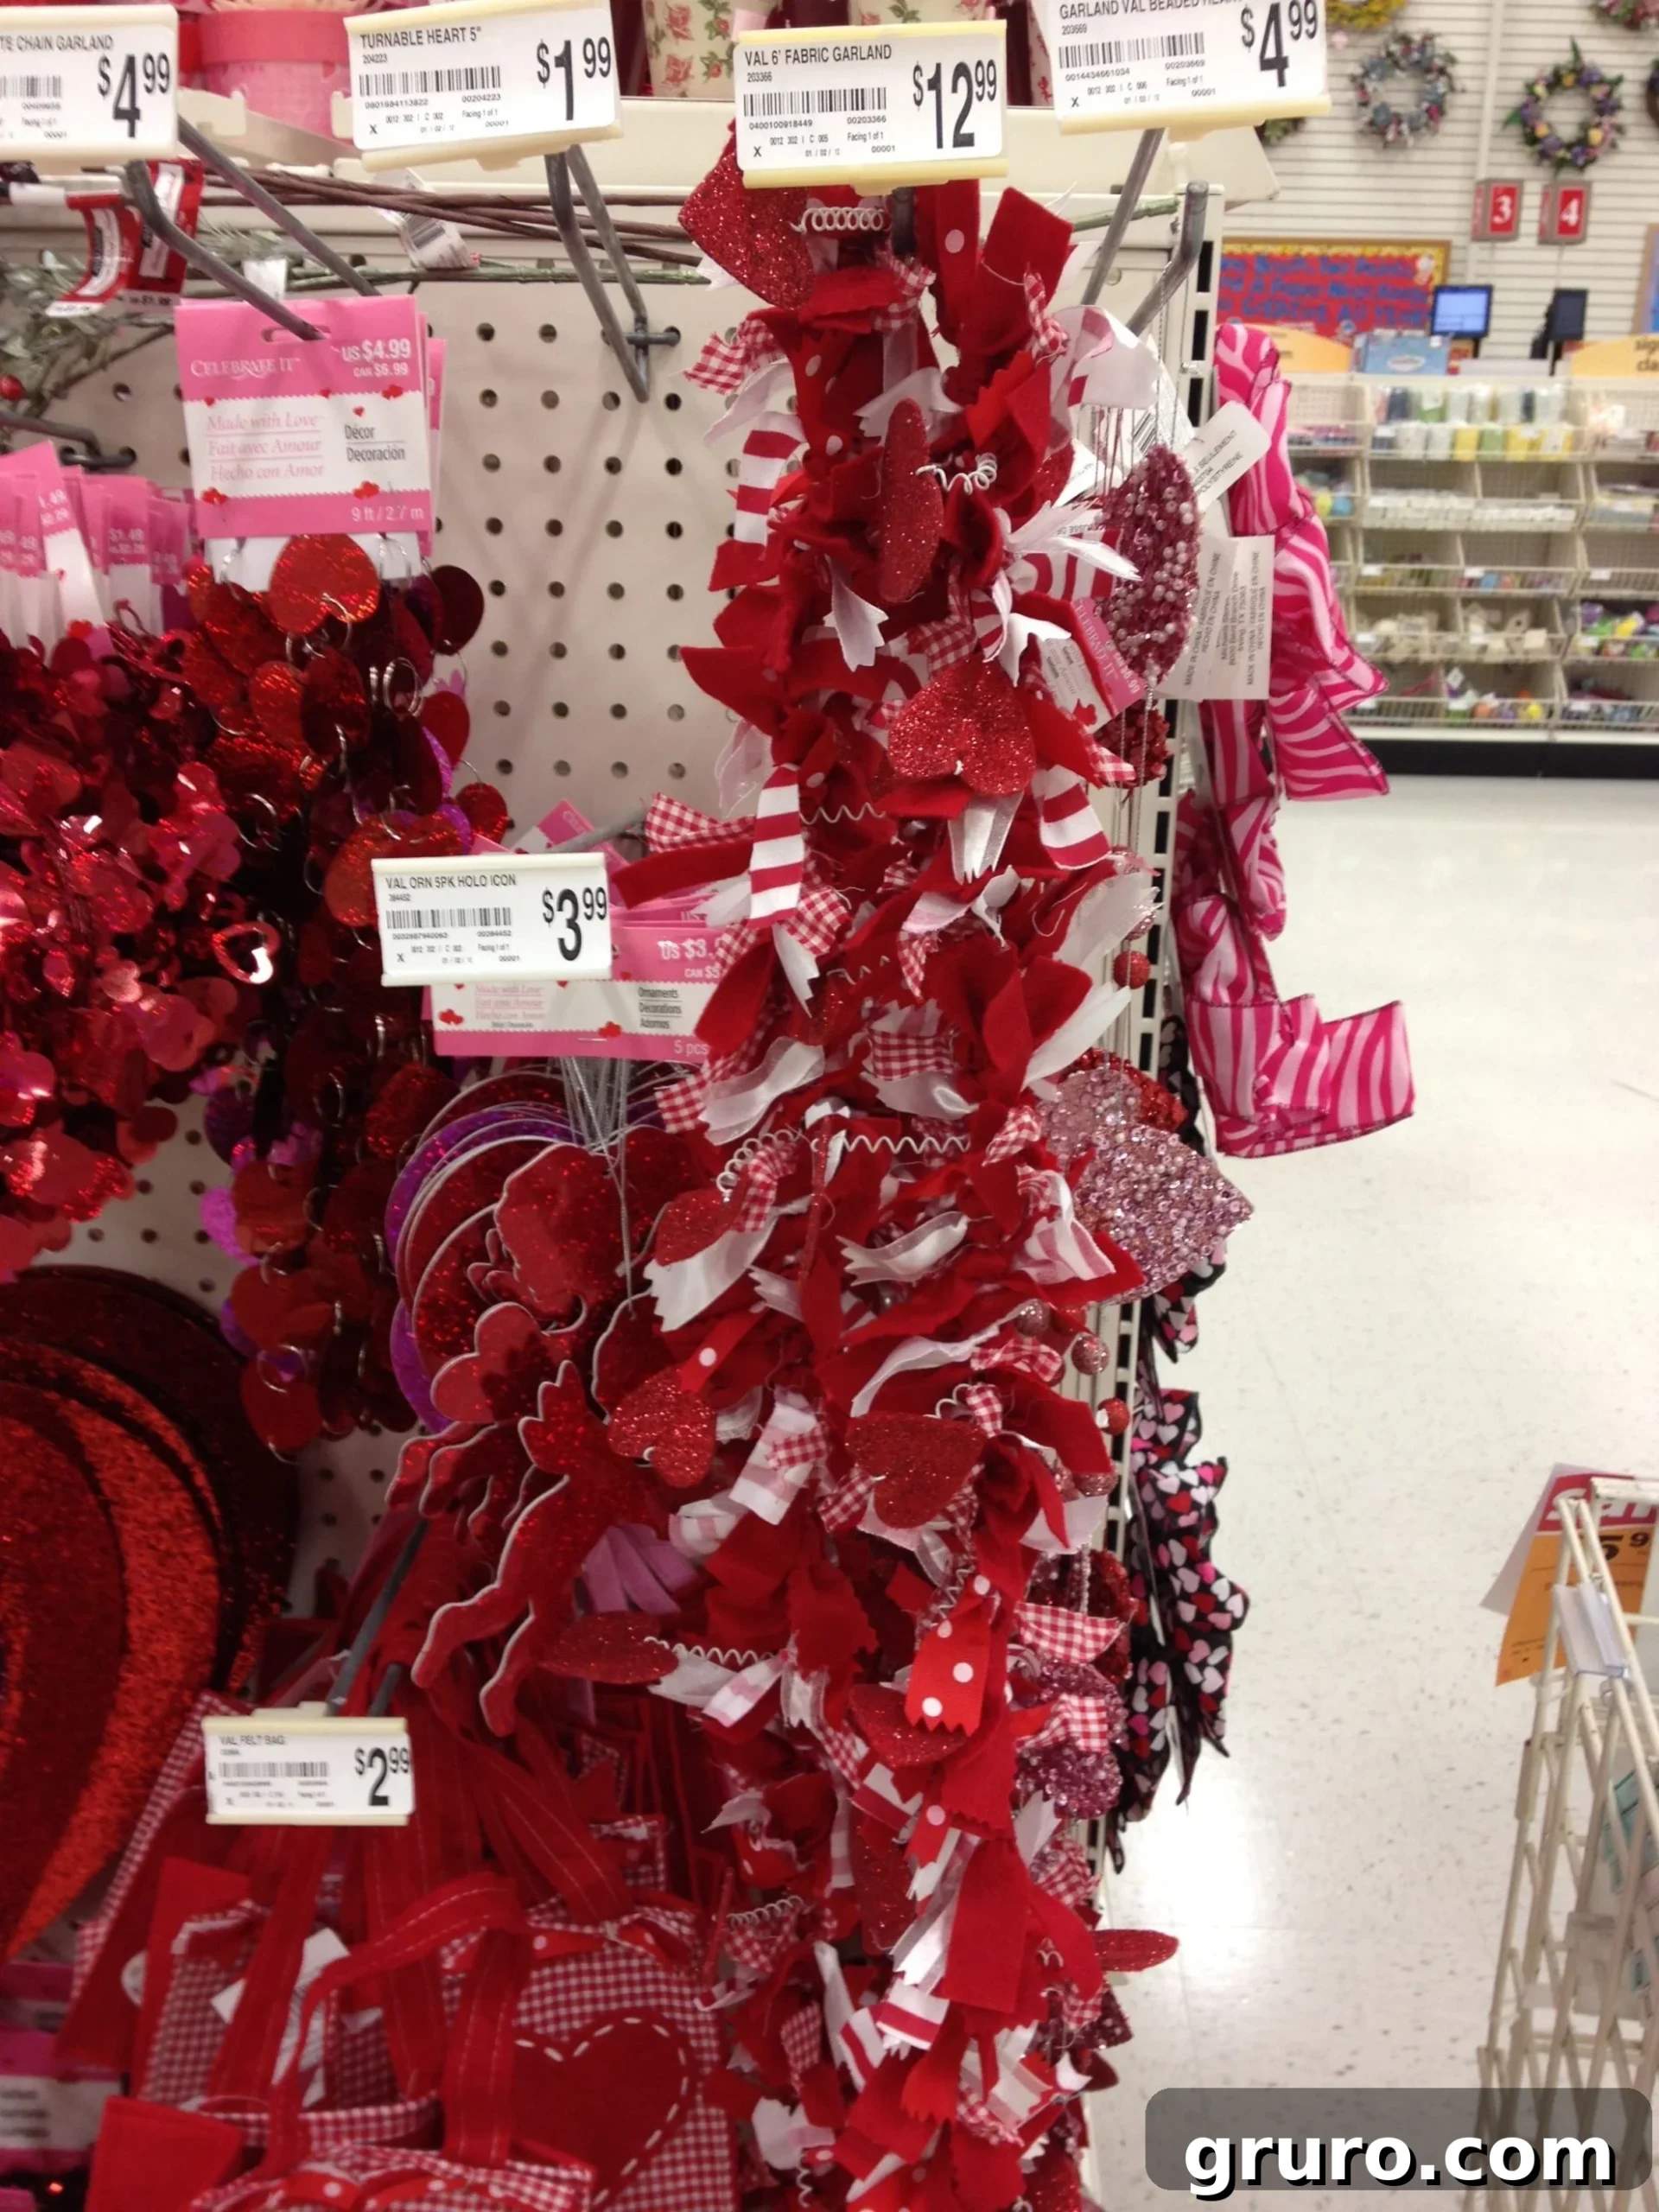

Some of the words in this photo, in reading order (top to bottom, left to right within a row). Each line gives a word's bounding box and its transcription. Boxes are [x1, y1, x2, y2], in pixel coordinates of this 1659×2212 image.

[1059, 2, 1118, 19] GARLAND
[1123, 0, 1146, 14] VAL
[16, 35, 54, 51] CHAIN
[56, 35, 114, 51] GARLAND
[360, 30, 423, 48] TURNABLE
[427, 28, 467, 43] HEART
[363, 54, 387, 64] 204223
[745, 49, 769, 67] VAL
[772, 49, 782, 65] 6'
[785, 47, 829, 64] FABRIC
[832, 44, 892, 62] GARLAND
[747, 71, 772, 83] 203366
[461, 93, 501, 103] 00204223
[1071, 97, 1079, 108] X
[461, 110, 481, 119] Facing
[369, 124, 378, 135] X
[749, 119, 813, 130] 0400100918449
[847, 116, 887, 124] 00203366
[847, 132, 867, 143] Facing
[753, 145, 762, 157] X
[1493, 195, 1512, 224] 3
[1560, 199, 1580, 226] 4
[341, 346, 360, 362] US
[362, 338, 411, 361] $4.99
[190, 358, 276, 380] CELEBRATE
[207, 415, 246, 430] Made
[251, 412, 281, 429] with
[284, 410, 318, 427] Love
[208, 439, 236, 456] Fait
[238, 442, 269, 455] avec
[271, 437, 321, 454] Amour
[210, 465, 254, 481] Hecho
[256, 467, 280, 477] con
[283, 461, 324, 478] Amor
[351, 507, 361, 522] 9
[364, 506, 373, 521] ft
[410, 507, 424, 519] m
[385, 877, 407, 889] VAL
[410, 876, 433, 889] ORN
[457, 874, 487, 887] HOLO
[490, 874, 517, 887] ICON
[638, 987, 678, 999] Ornaments
[674, 1039, 683, 1054] 5
[686, 1042, 709, 1057] pcs
